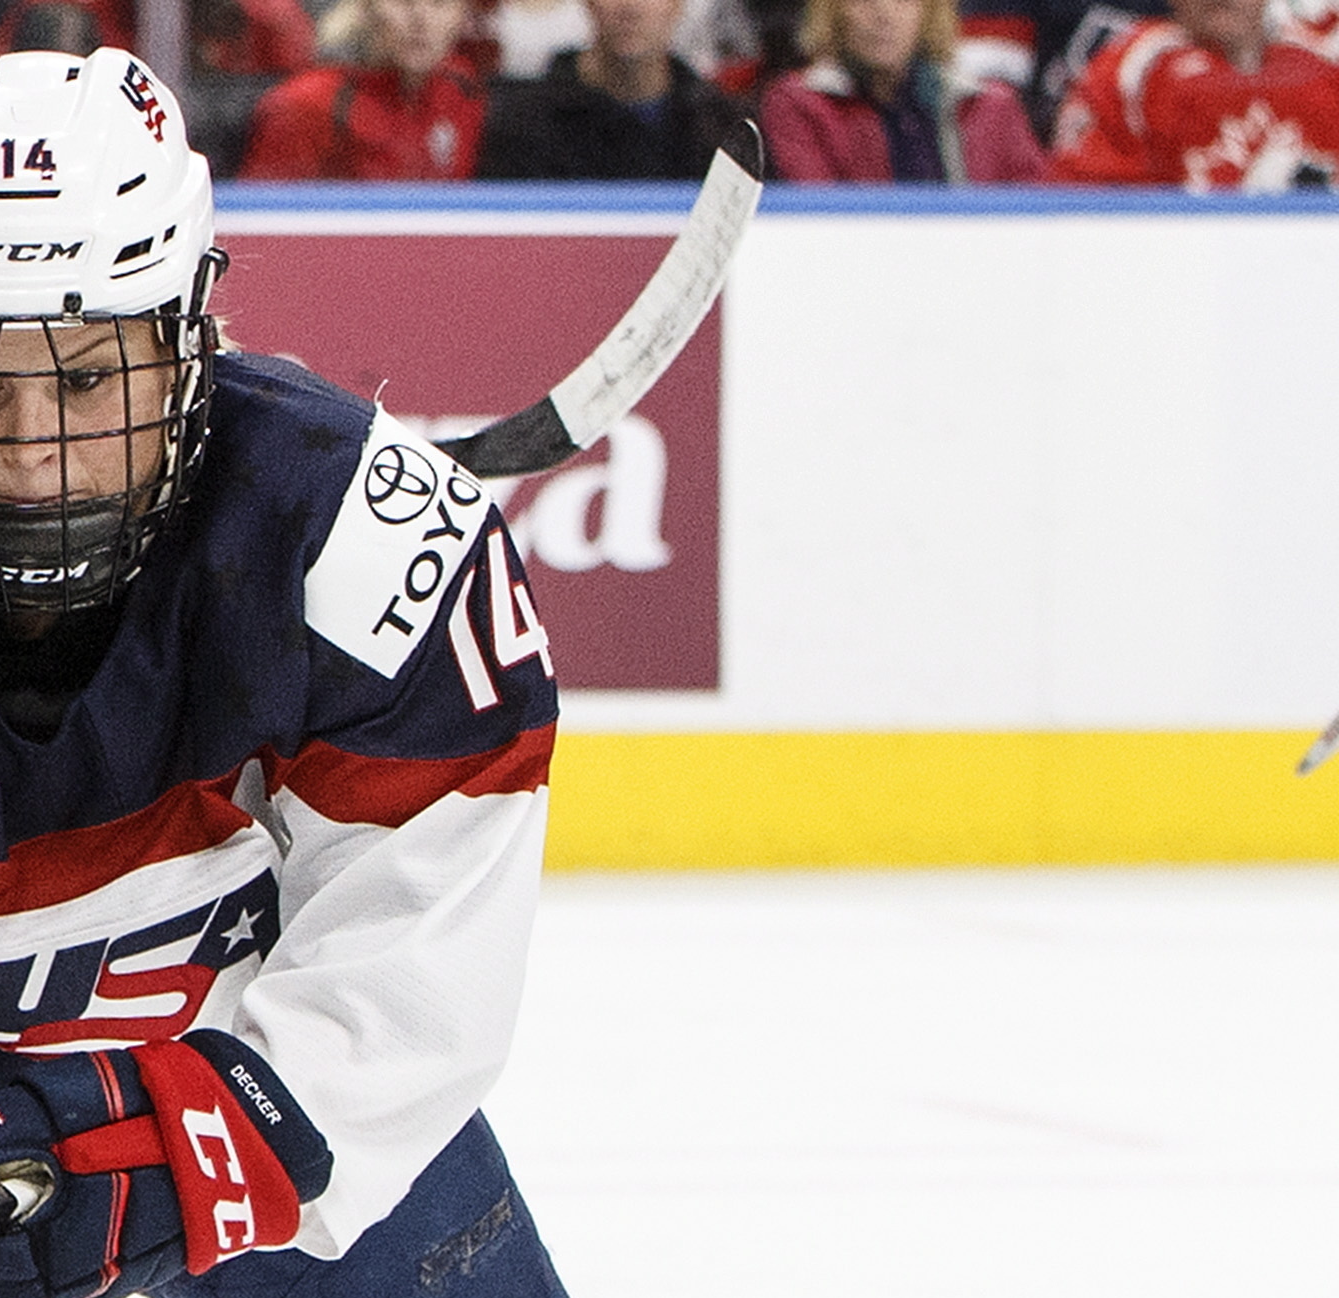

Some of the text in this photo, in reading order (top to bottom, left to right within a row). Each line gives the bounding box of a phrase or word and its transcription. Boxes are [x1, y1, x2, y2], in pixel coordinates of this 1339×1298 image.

[0, 137, 58, 181] 14
[371, 462, 485, 638] TOYO
[445, 524, 555, 713] 14
[228, 1062, 284, 1127] DECKER
[180, 1102, 256, 1264] CC
